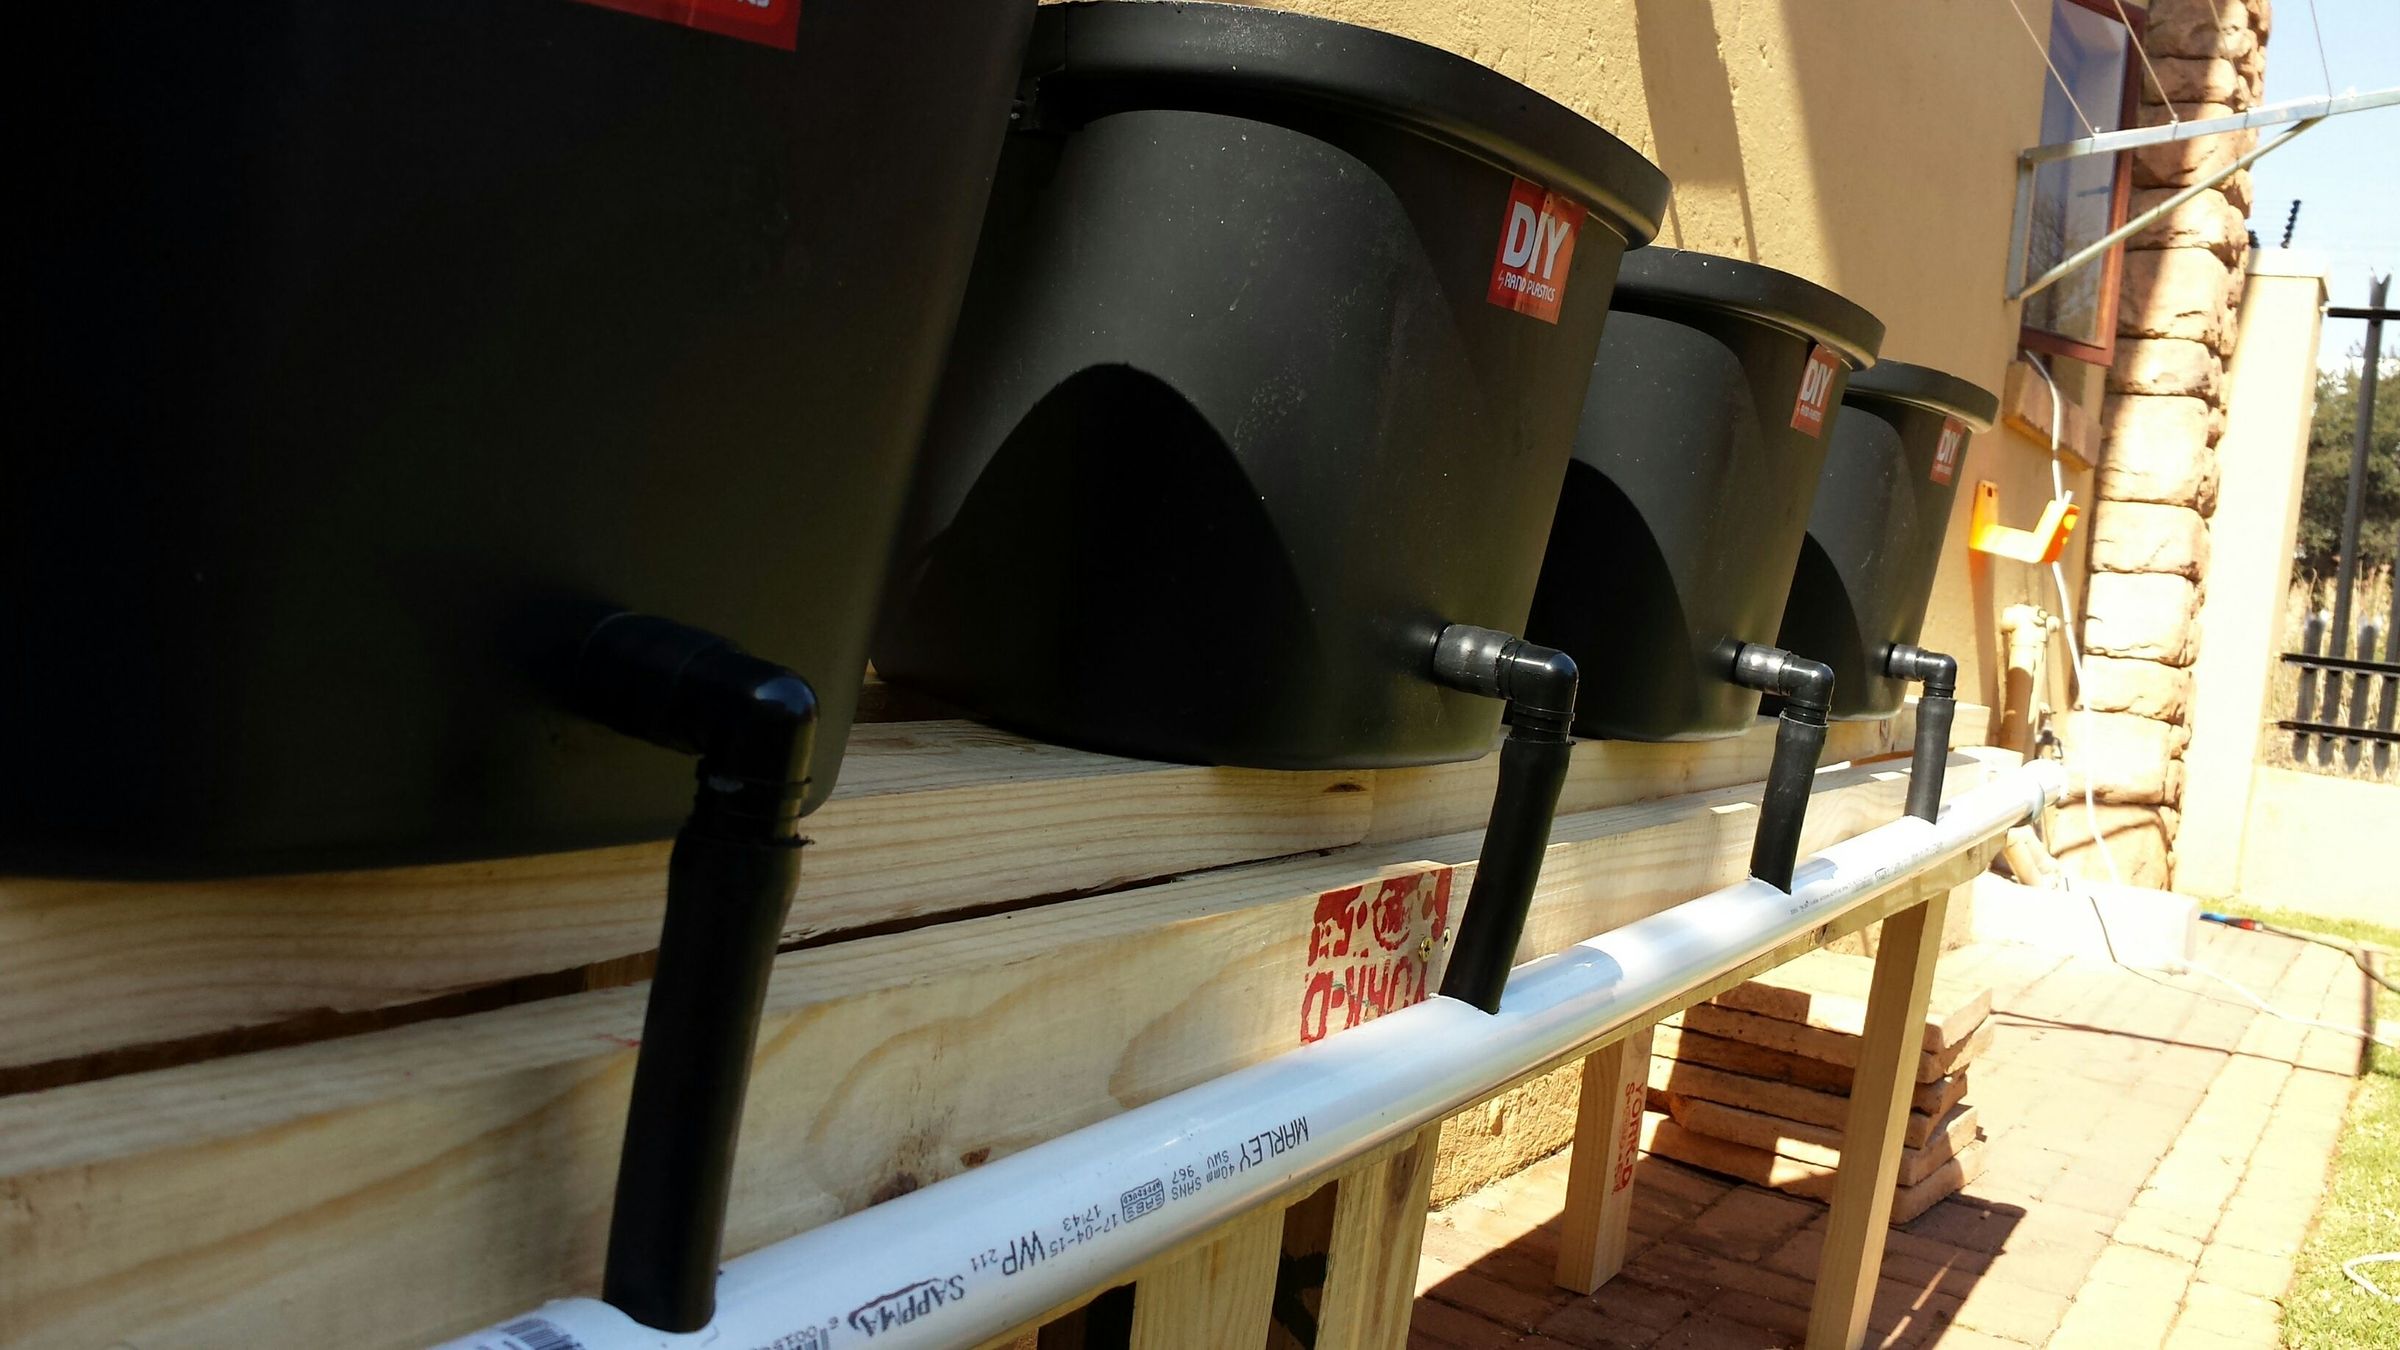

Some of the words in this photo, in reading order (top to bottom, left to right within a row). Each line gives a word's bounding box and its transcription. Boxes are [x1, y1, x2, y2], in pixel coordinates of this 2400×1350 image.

[1502, 201, 1571, 280] DIY
[1527, 280, 1556, 302] PLASTICS
[1800, 358, 1833, 407] DIY
[1936, 429, 1960, 464] DIY
[1240, 1116, 1309, 1172] MARLEY
[1172, 1165, 1195, 1185] 967
[1206, 1164, 1235, 1182] 40mm
[1122, 1181, 1161, 1204] APPROVED
[1171, 1177, 1202, 1200] SANS
[1126, 1196, 1163, 1217] SABS
[1049, 1213, 1117, 1258] 17-04-15
[970, 1248, 998, 1272] 211
[1002, 1230, 1046, 1276] WP
[858, 1275, 965, 1337] SAPPMA
